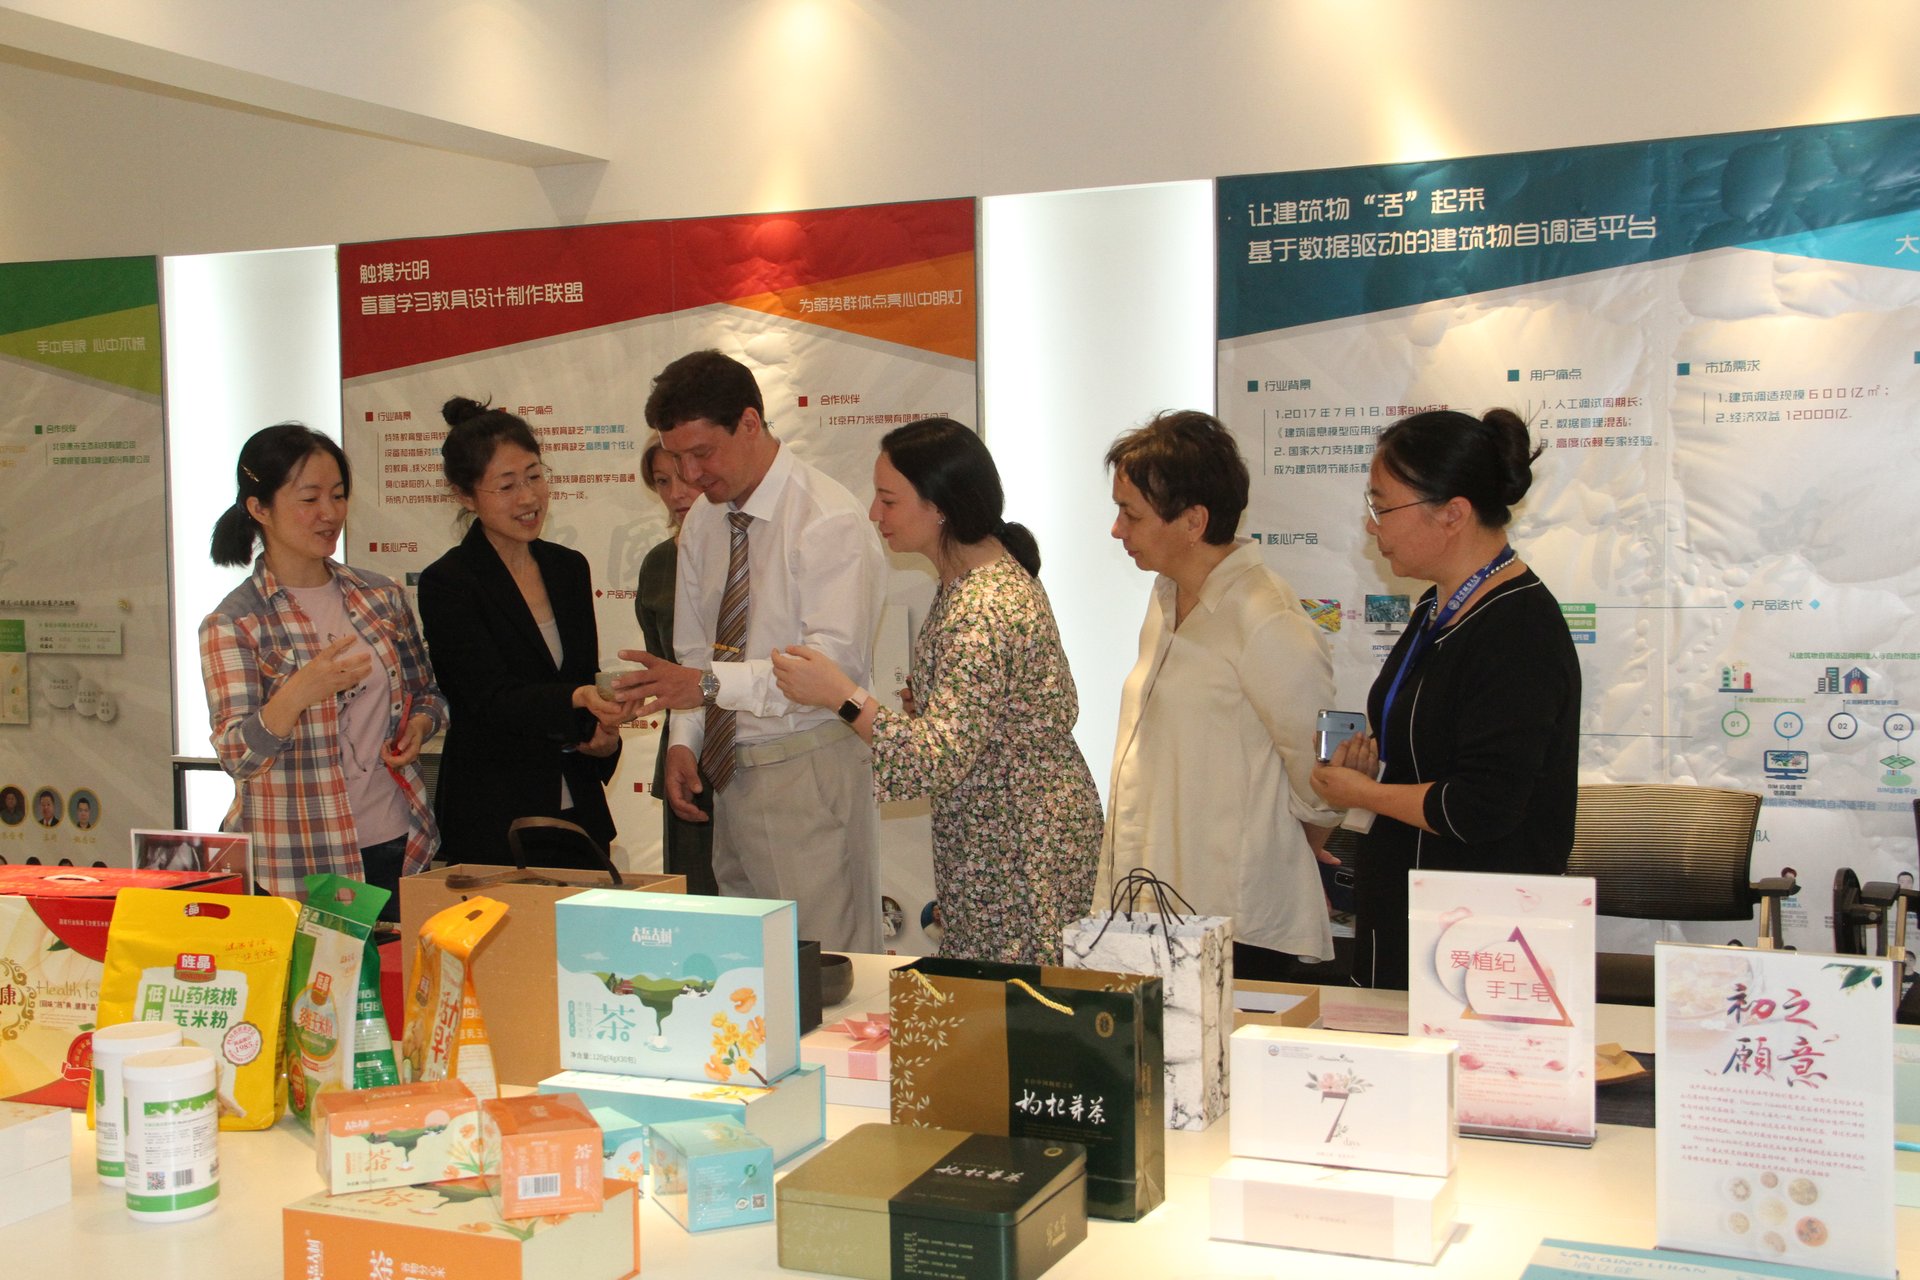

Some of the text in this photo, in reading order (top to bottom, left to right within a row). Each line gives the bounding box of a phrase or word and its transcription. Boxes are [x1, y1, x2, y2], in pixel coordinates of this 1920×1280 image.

[1248, 199, 1350, 227] 让建筑物
[1431, 187, 1485, 214] 起来
[1247, 214, 1657, 264] 基于数据驱动的建筑物自调适平台
[360, 260, 429, 283] 触摸光明
[361, 282, 584, 315] 盲童学习教具设计制作联盟
[800, 289, 963, 313] 为弱势群体点亮心中明灯
[1529, 368, 1582, 381] 用户痛点
[1704, 359, 1760, 374] 市场需求
[1265, 379, 1311, 391] 行业背景
[821, 394, 860, 405] 合作伙伴
[1717, 388, 1805, 403] 1.建筑调适规模
[378, 411, 411, 421] 行业背景
[518, 406, 553, 415] 用户痛点
[1715, 409, 1780, 423] 2.经济效益
[385, 431, 449, 442] 特殊教育是运用特
[385, 448, 443, 457] 设备和措施对特
[381, 542, 417, 552] 核心产品
[1267, 533, 1319, 545] 核心产品
[1752, 600, 1803, 610] 产品迭代
[1451, 950, 1516, 973] 爱植纪
[36, 979, 100, 1002] Health fo
[169, 985, 238, 1007] 山药核桃
[1486, 980, 1551, 1003] 手工皂
[173, 1009, 228, 1029] 玉米粉
[593, 1003, 637, 1041] 茶
[1015, 1089, 1107, 1125] 枸杞芽茶
[1321, 1091, 1350, 1143] 7
